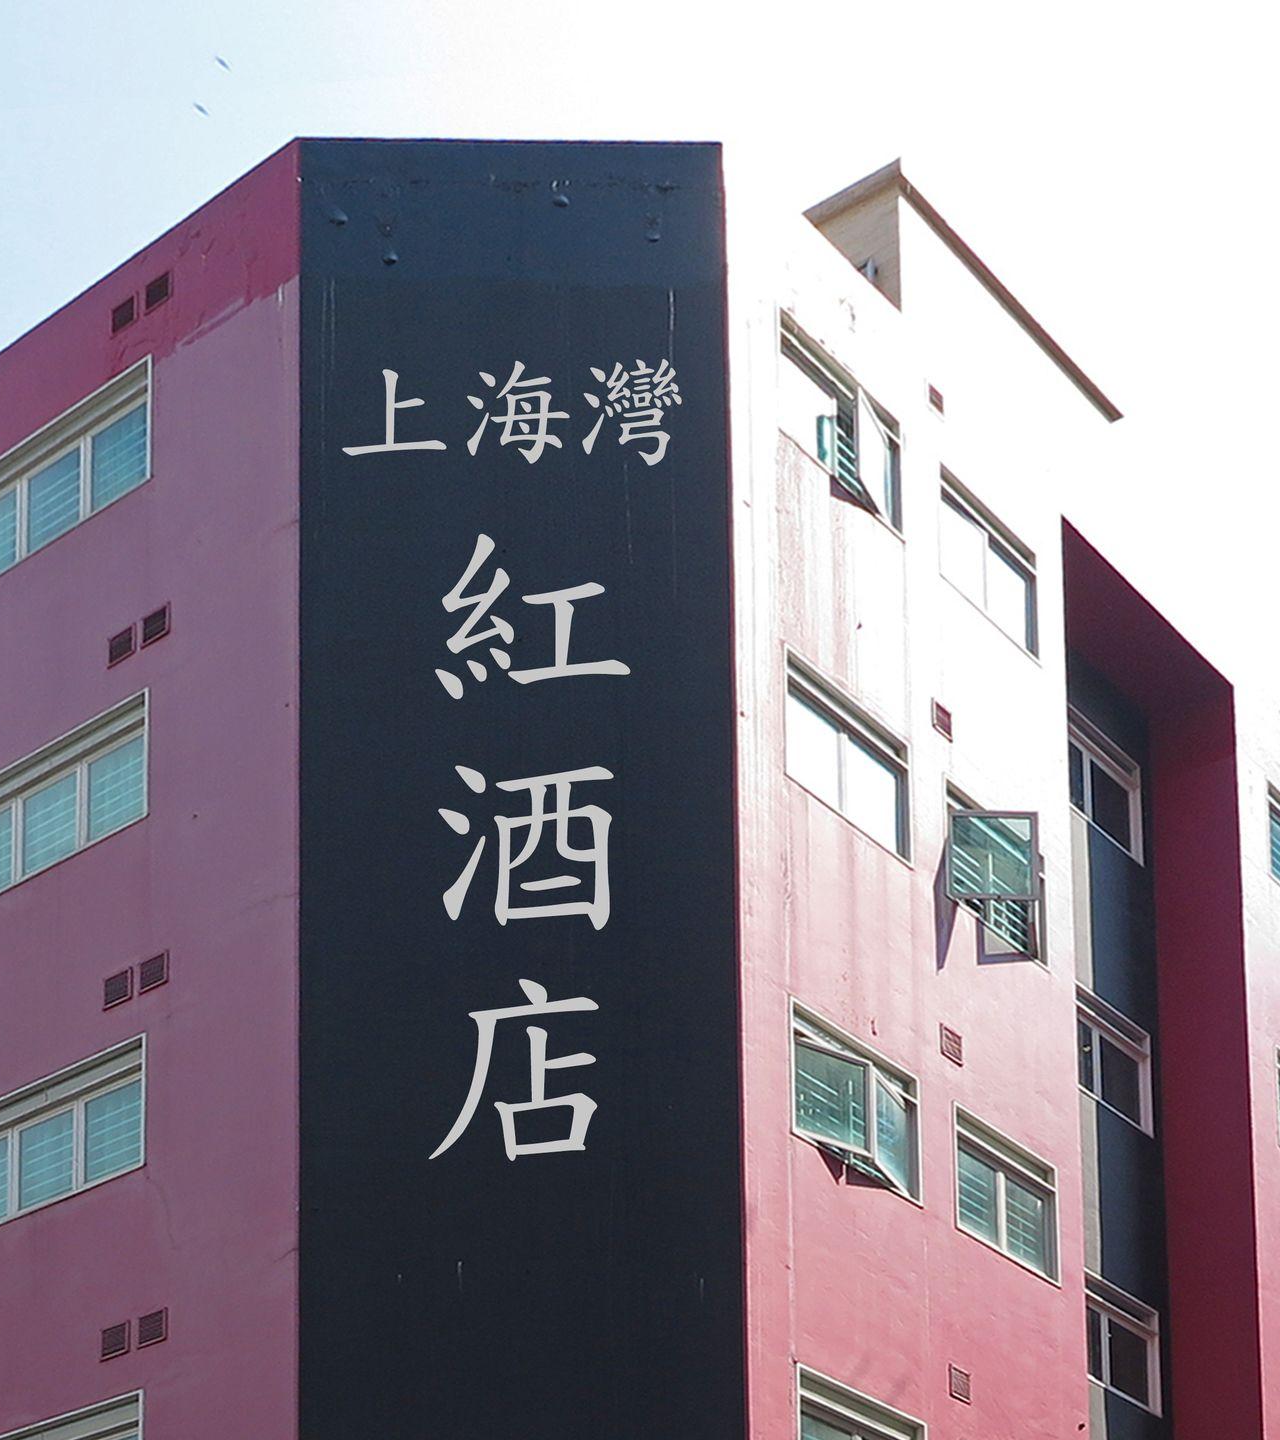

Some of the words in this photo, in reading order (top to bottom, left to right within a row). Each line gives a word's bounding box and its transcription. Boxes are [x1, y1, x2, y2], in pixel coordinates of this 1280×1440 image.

[340, 358, 685, 467] 上海灣
[427, 532, 632, 1162] 紅酒店
